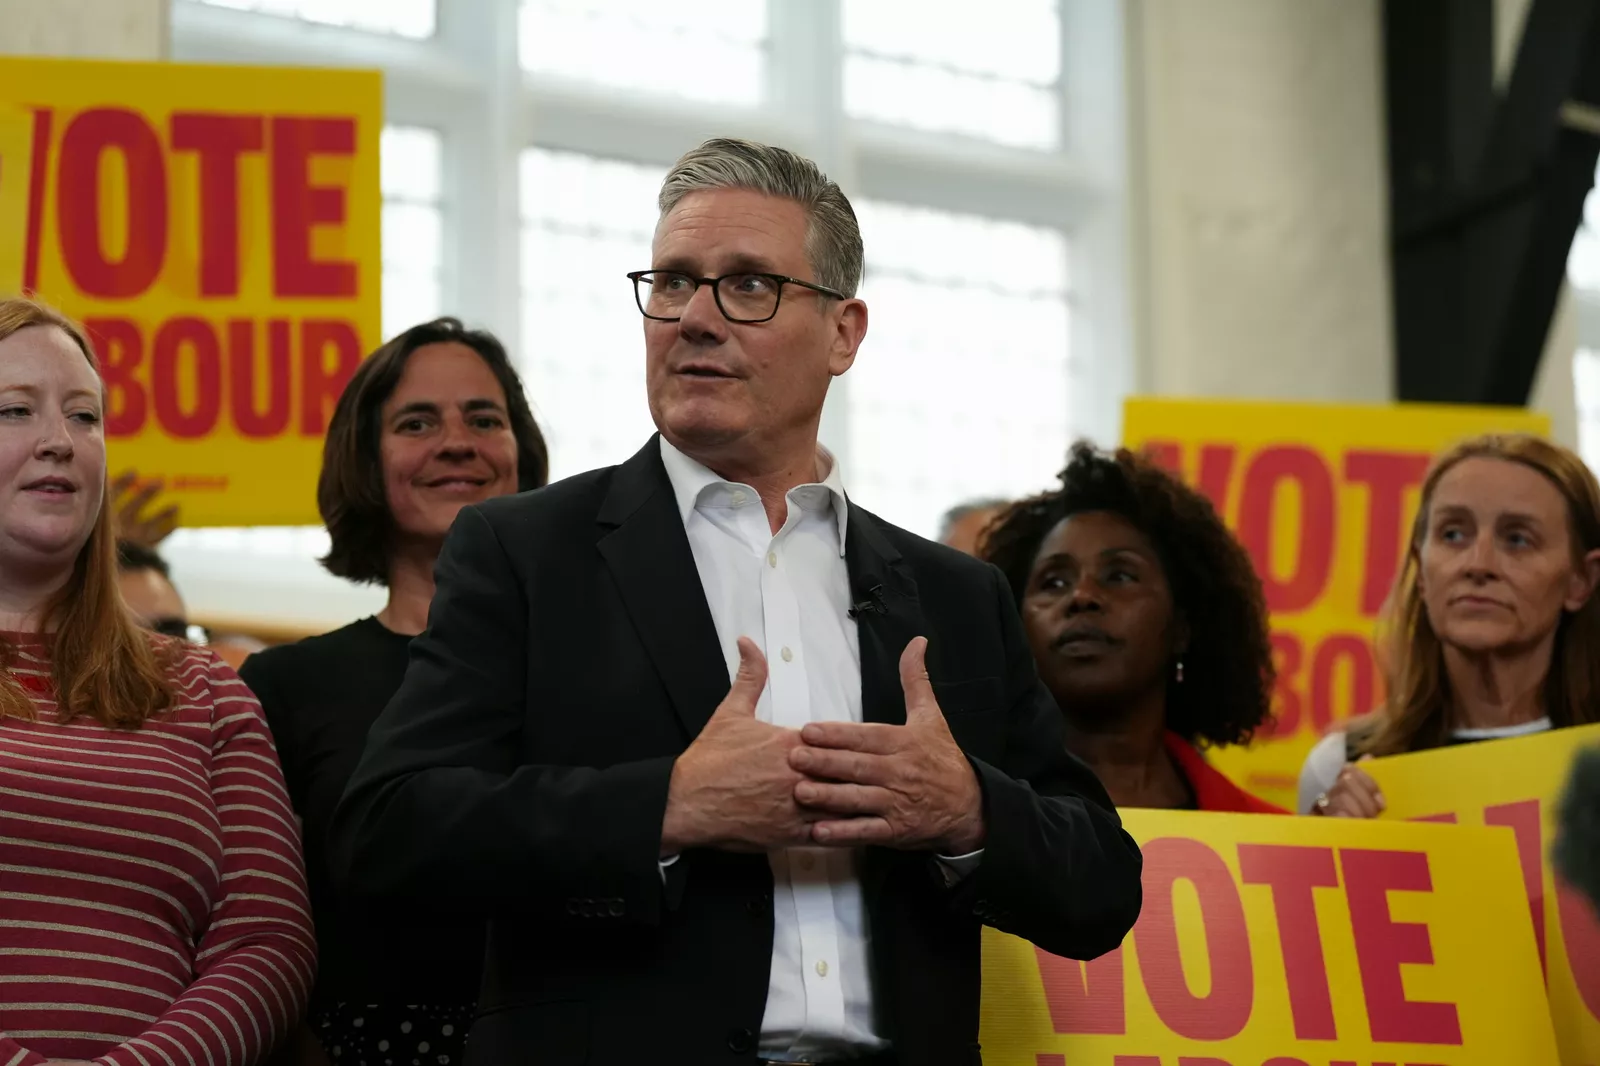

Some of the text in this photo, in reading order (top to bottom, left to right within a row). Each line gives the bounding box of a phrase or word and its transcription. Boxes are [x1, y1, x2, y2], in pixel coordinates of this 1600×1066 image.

[24, 106, 357, 299] OTE
[84, 315, 361, 439] BOUR
[1144, 440, 1430, 616] OT
